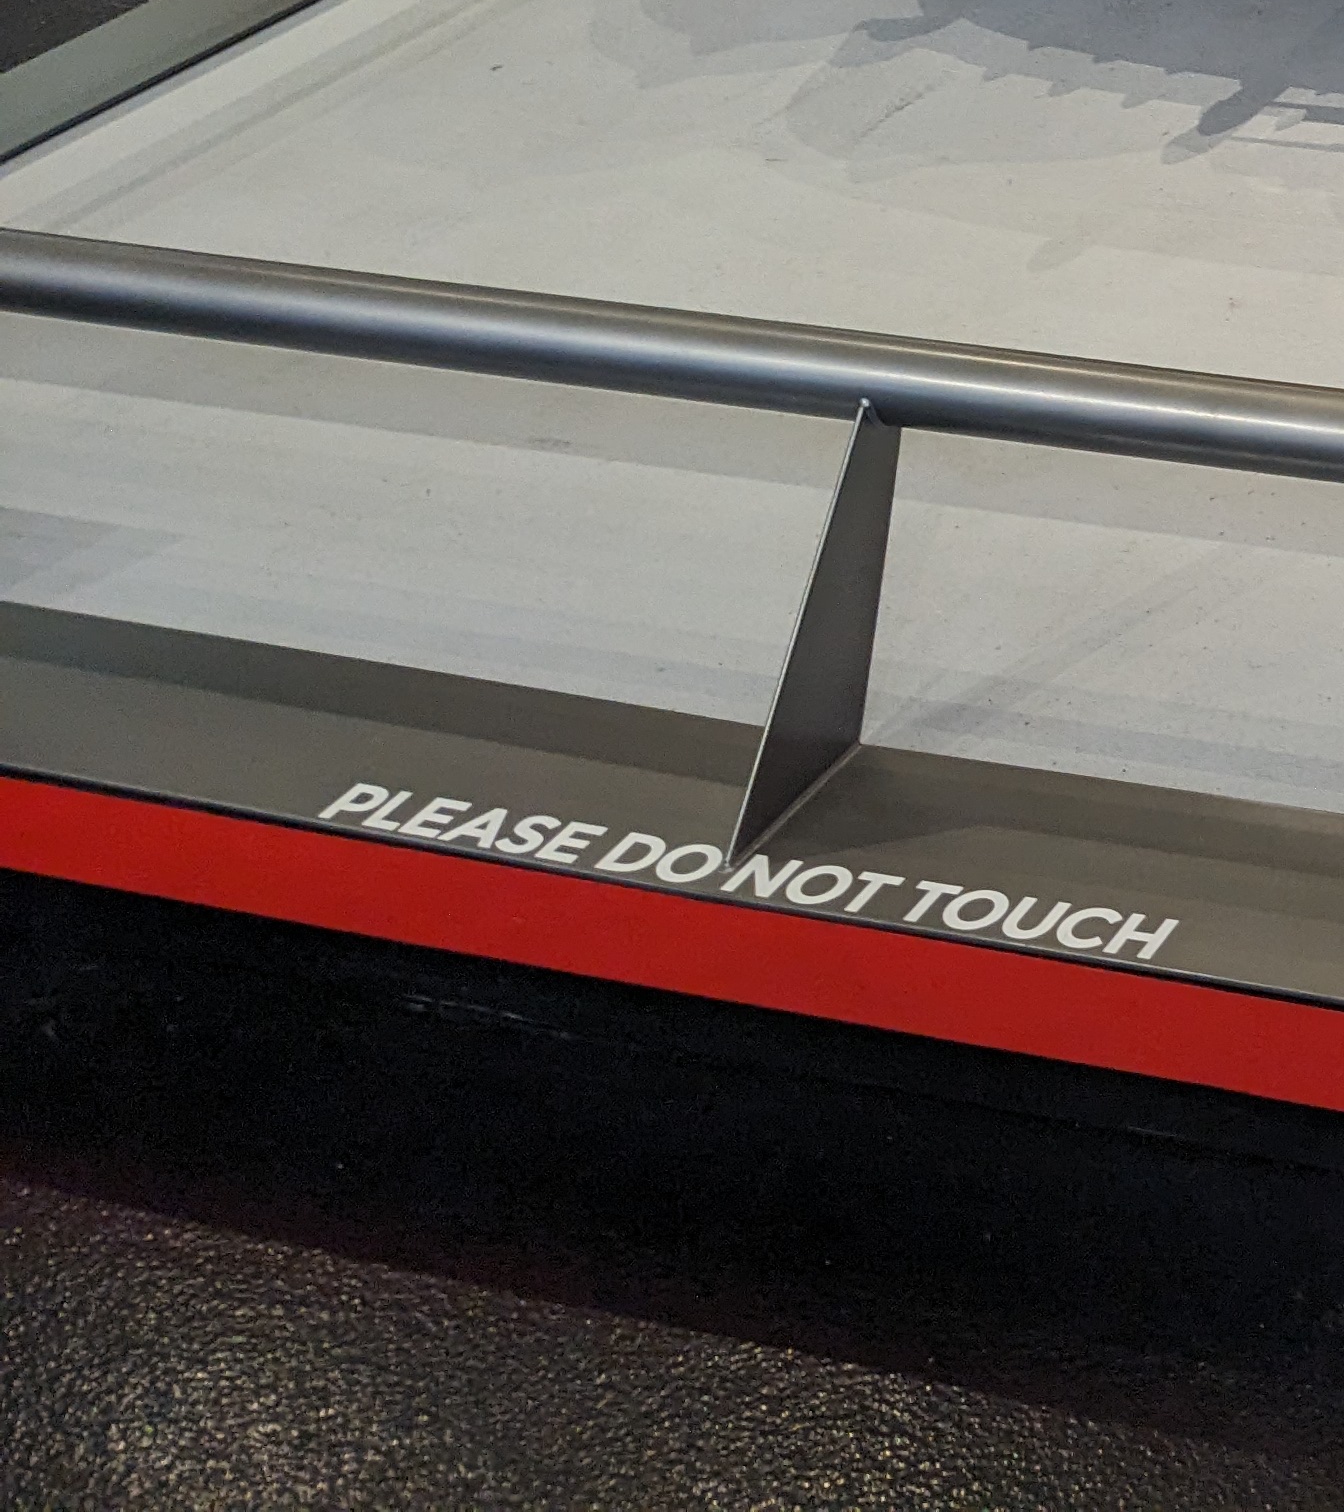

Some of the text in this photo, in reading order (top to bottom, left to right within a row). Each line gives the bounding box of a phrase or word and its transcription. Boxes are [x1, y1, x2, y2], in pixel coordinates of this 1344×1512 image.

[318, 782, 1180, 961] PLEASE DO NOT TOUCH
